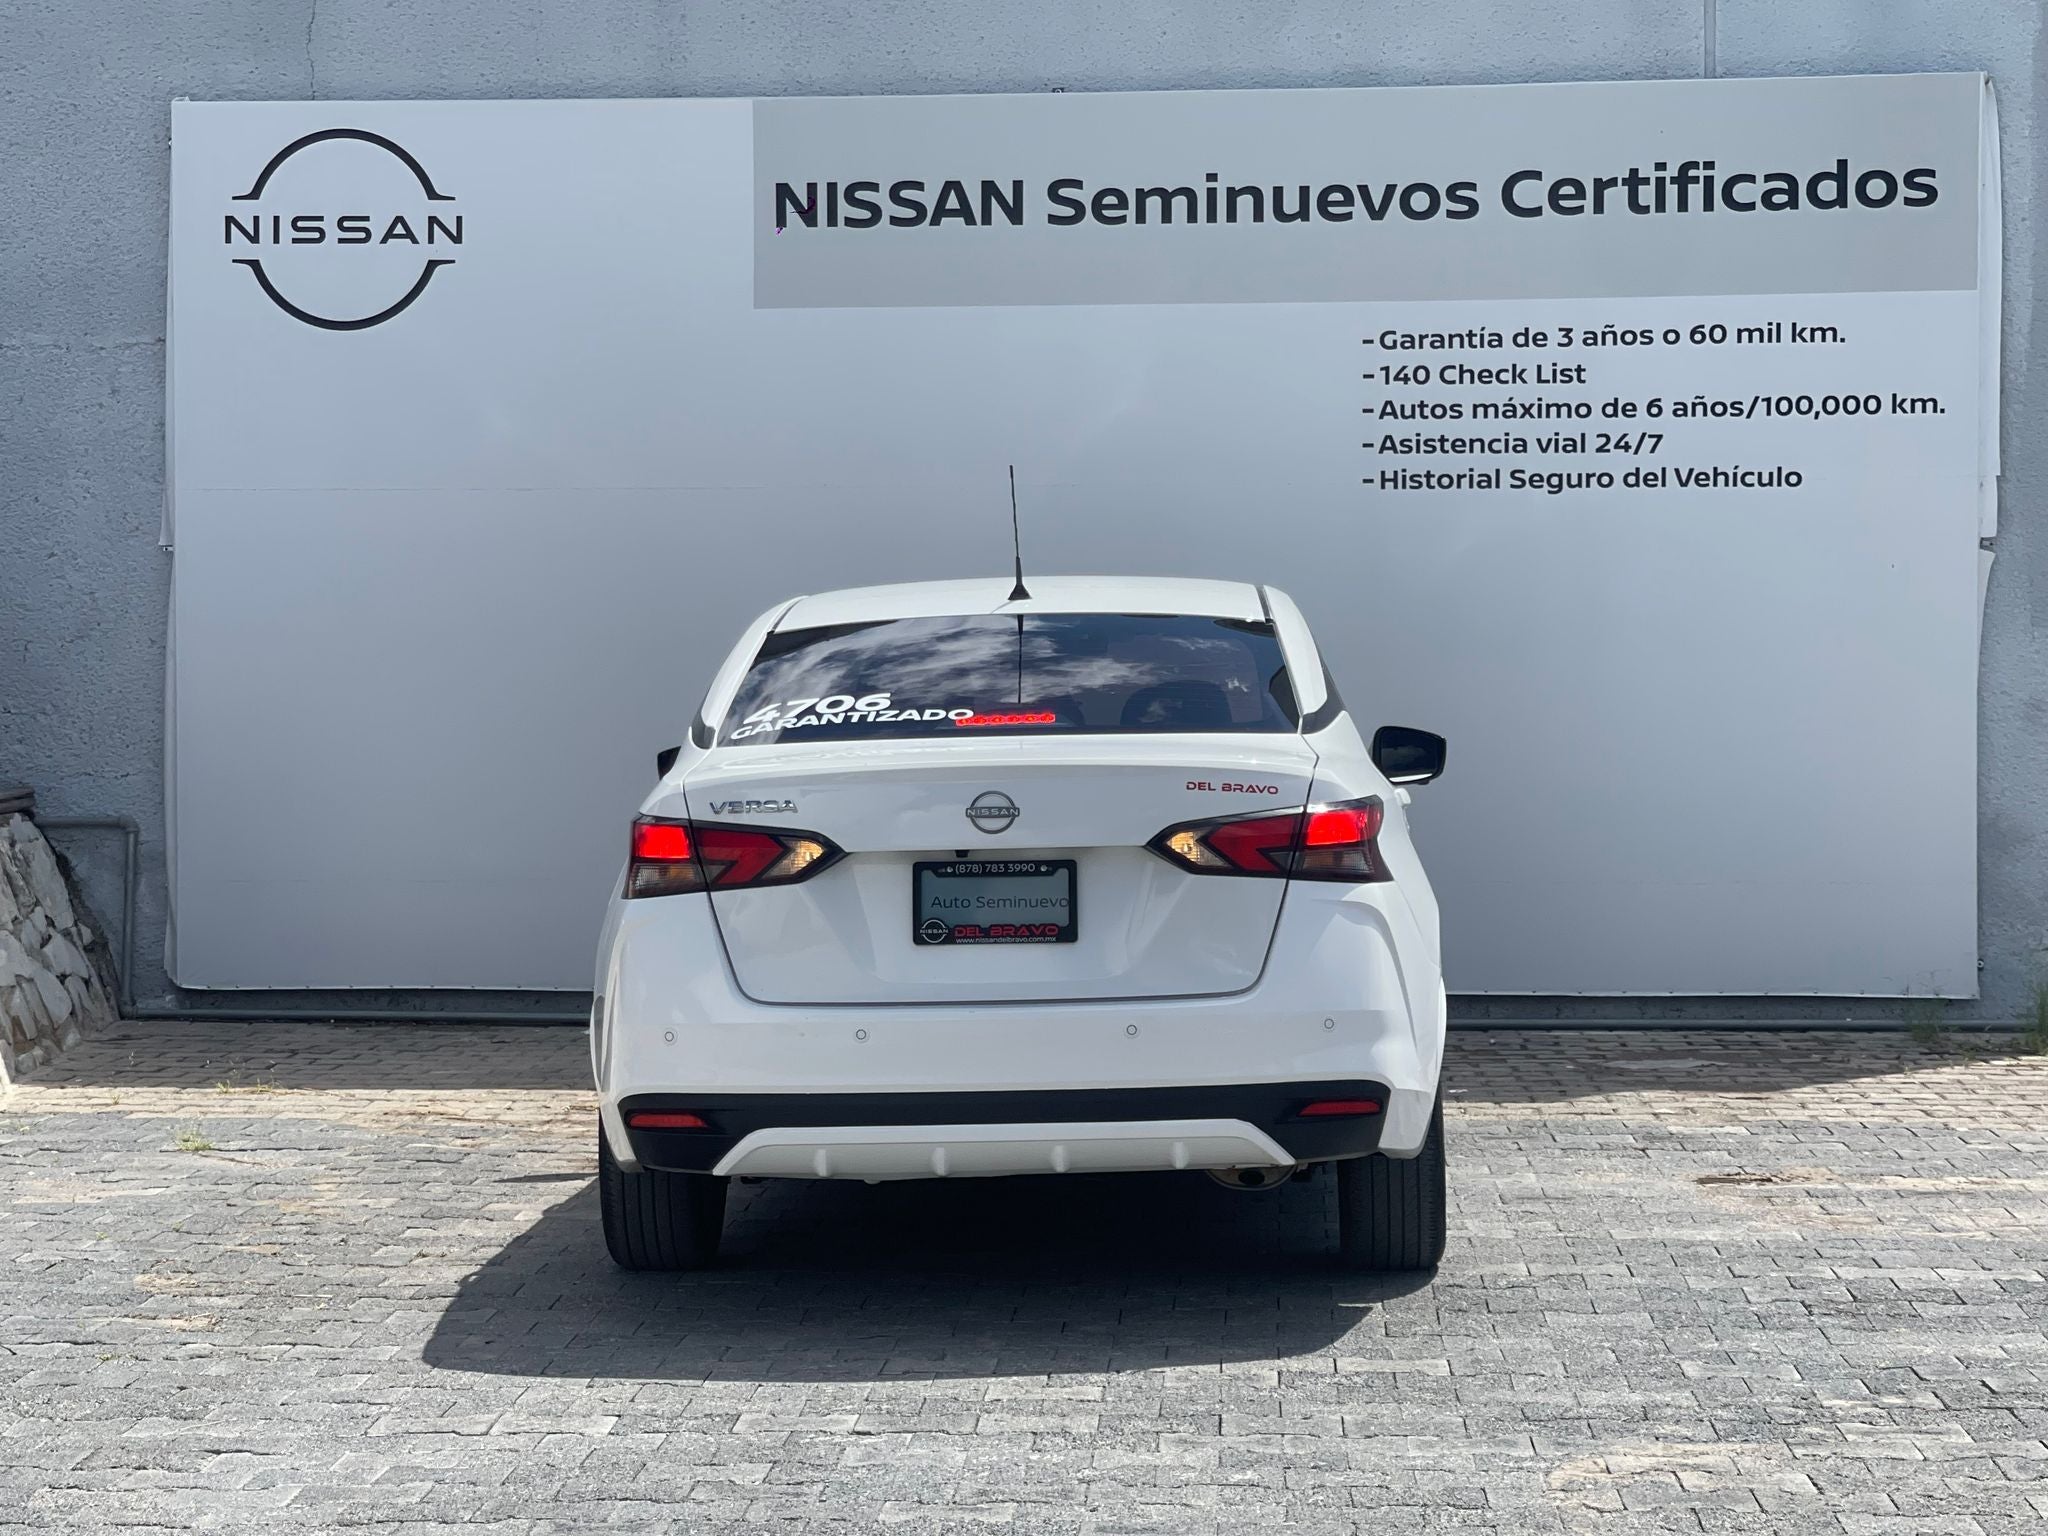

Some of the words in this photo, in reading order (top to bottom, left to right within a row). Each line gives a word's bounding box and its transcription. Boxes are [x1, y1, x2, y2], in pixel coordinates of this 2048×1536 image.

[776, 180, 1023, 230] NISSAN
[1047, 173, 1479, 226] Seminuevos
[1501, 159, 1938, 218] Certificados
[225, 216, 462, 244] NISSAN
[1362, 327, 1503, 350] -Garantía
[1512, 327, 1548, 348] de
[1557, 328, 1573, 347] 3
[1582, 324, 1654, 346] años
[1663, 329, 1680, 345] o
[1690, 324, 1727, 344] 60
[1737, 322, 1781, 343] mil
[1792, 322, 1845, 343] km.
[1362, 365, 1430, 385] -140
[1439, 364, 1528, 385] Check
[1537, 363, 1586, 384] List
[1362, 400, 1463, 421] -Autos
[1473, 397, 1592, 419] máximo
[1602, 397, 1637, 418] de
[1646, 398, 1663, 418] 6
[1672, 395, 1881, 420] años/100,000
[1892, 393, 1945, 414] km.
[1362, 432, 1527, 454] -Asistencia
[1536, 432, 1585, 453] vial
[1595, 432, 1663, 455] 24/7
[1362, 468, 1500, 490] -Historial
[1510, 469, 1614, 494] Seguro
[1623, 467, 1666, 488] del
[1674, 465, 1802, 487] Vehículo
[743, 693, 891, 724] 4706
[730, 709, 974, 740] GARANTIZADO
[1186, 782, 1216, 791] DEL
[1221, 783, 1279, 795] BRAVO
[709, 800, 798, 815] VERSA
[967, 808, 1019, 816] NISSAN
[955, 864, 983, 874] (878)
[985, 863, 1005, 873] 783
[1007, 863, 1036, 872] 3990
[931, 896, 971, 908] Auto
[975, 895, 1070, 909] Seminuevo
[955, 926, 985, 937] DEL
[990, 925, 1059, 937] BRAVO
[955, 936, 1057, 944] www.nissandelbravo.com.mx
